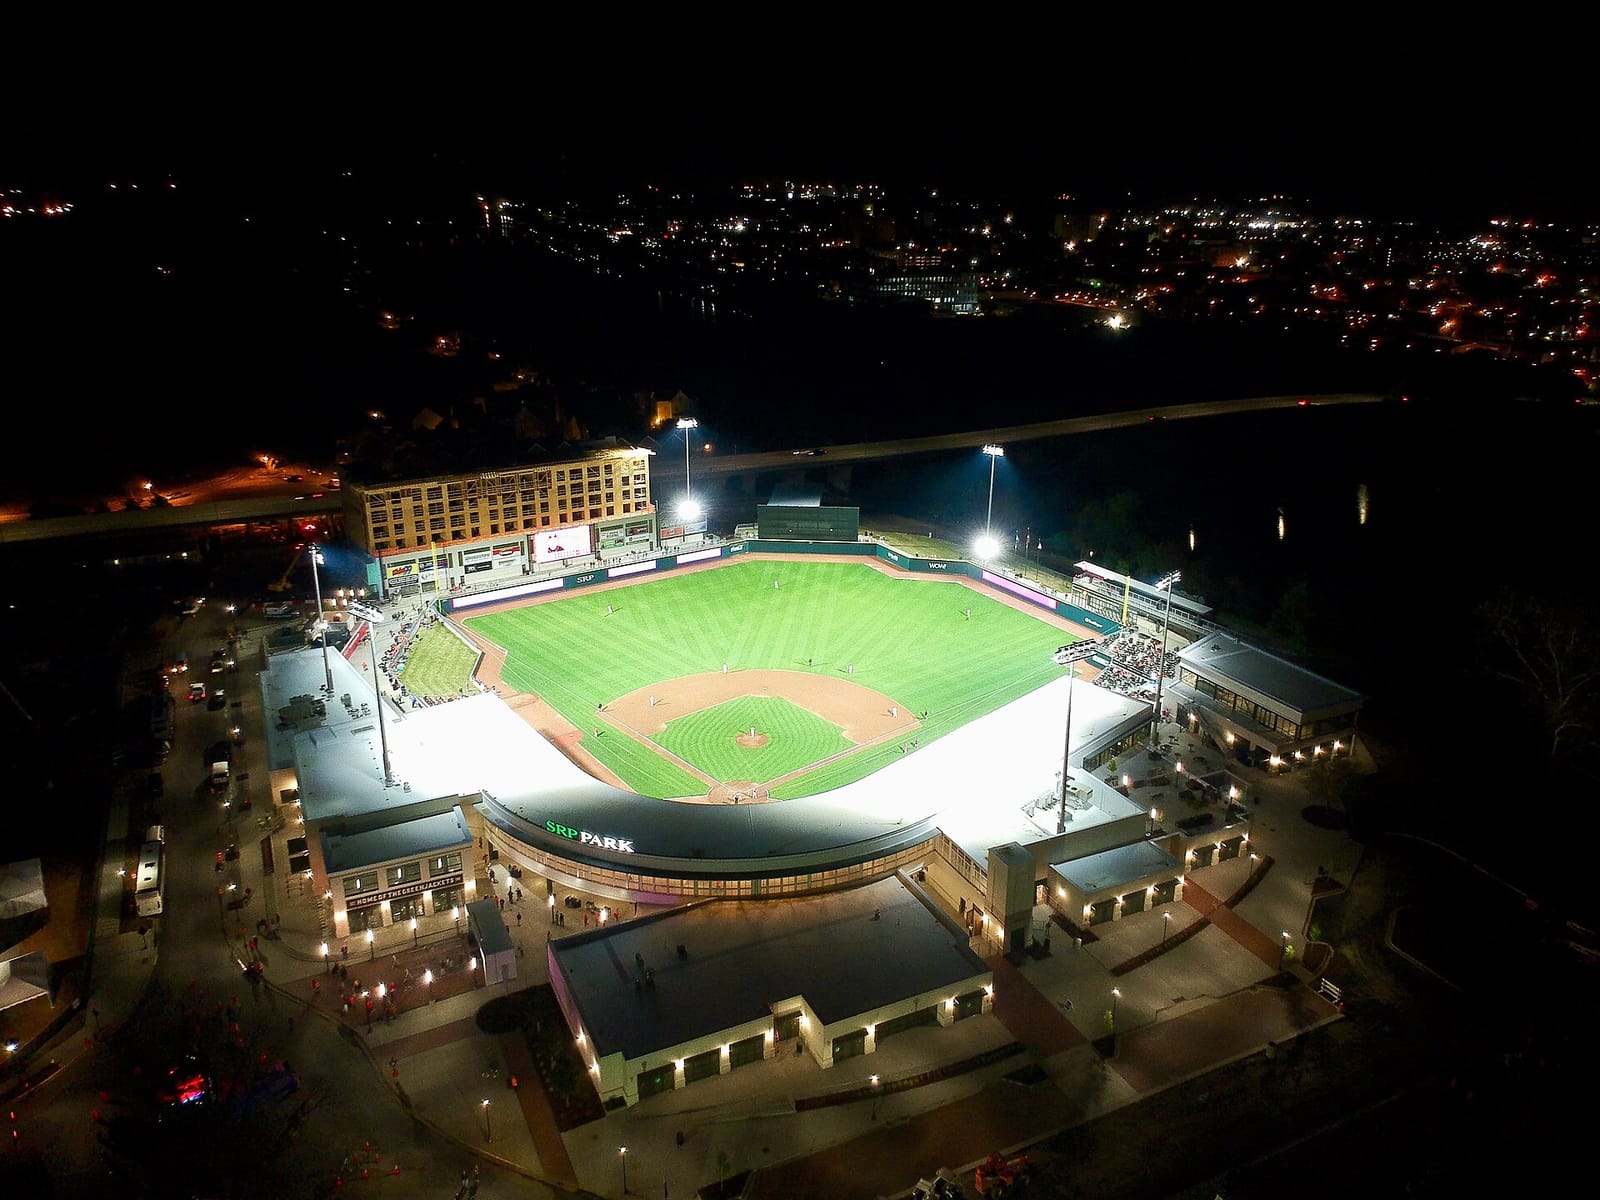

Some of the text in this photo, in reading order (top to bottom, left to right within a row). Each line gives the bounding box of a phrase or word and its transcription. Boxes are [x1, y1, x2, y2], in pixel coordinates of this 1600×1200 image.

[576, 574, 594, 583] SRP
[545, 820, 635, 853] SRP PARK
[356, 895, 378, 905] HOME
[377, 893, 388, 901] OF
[388, 889, 402, 898] THE
